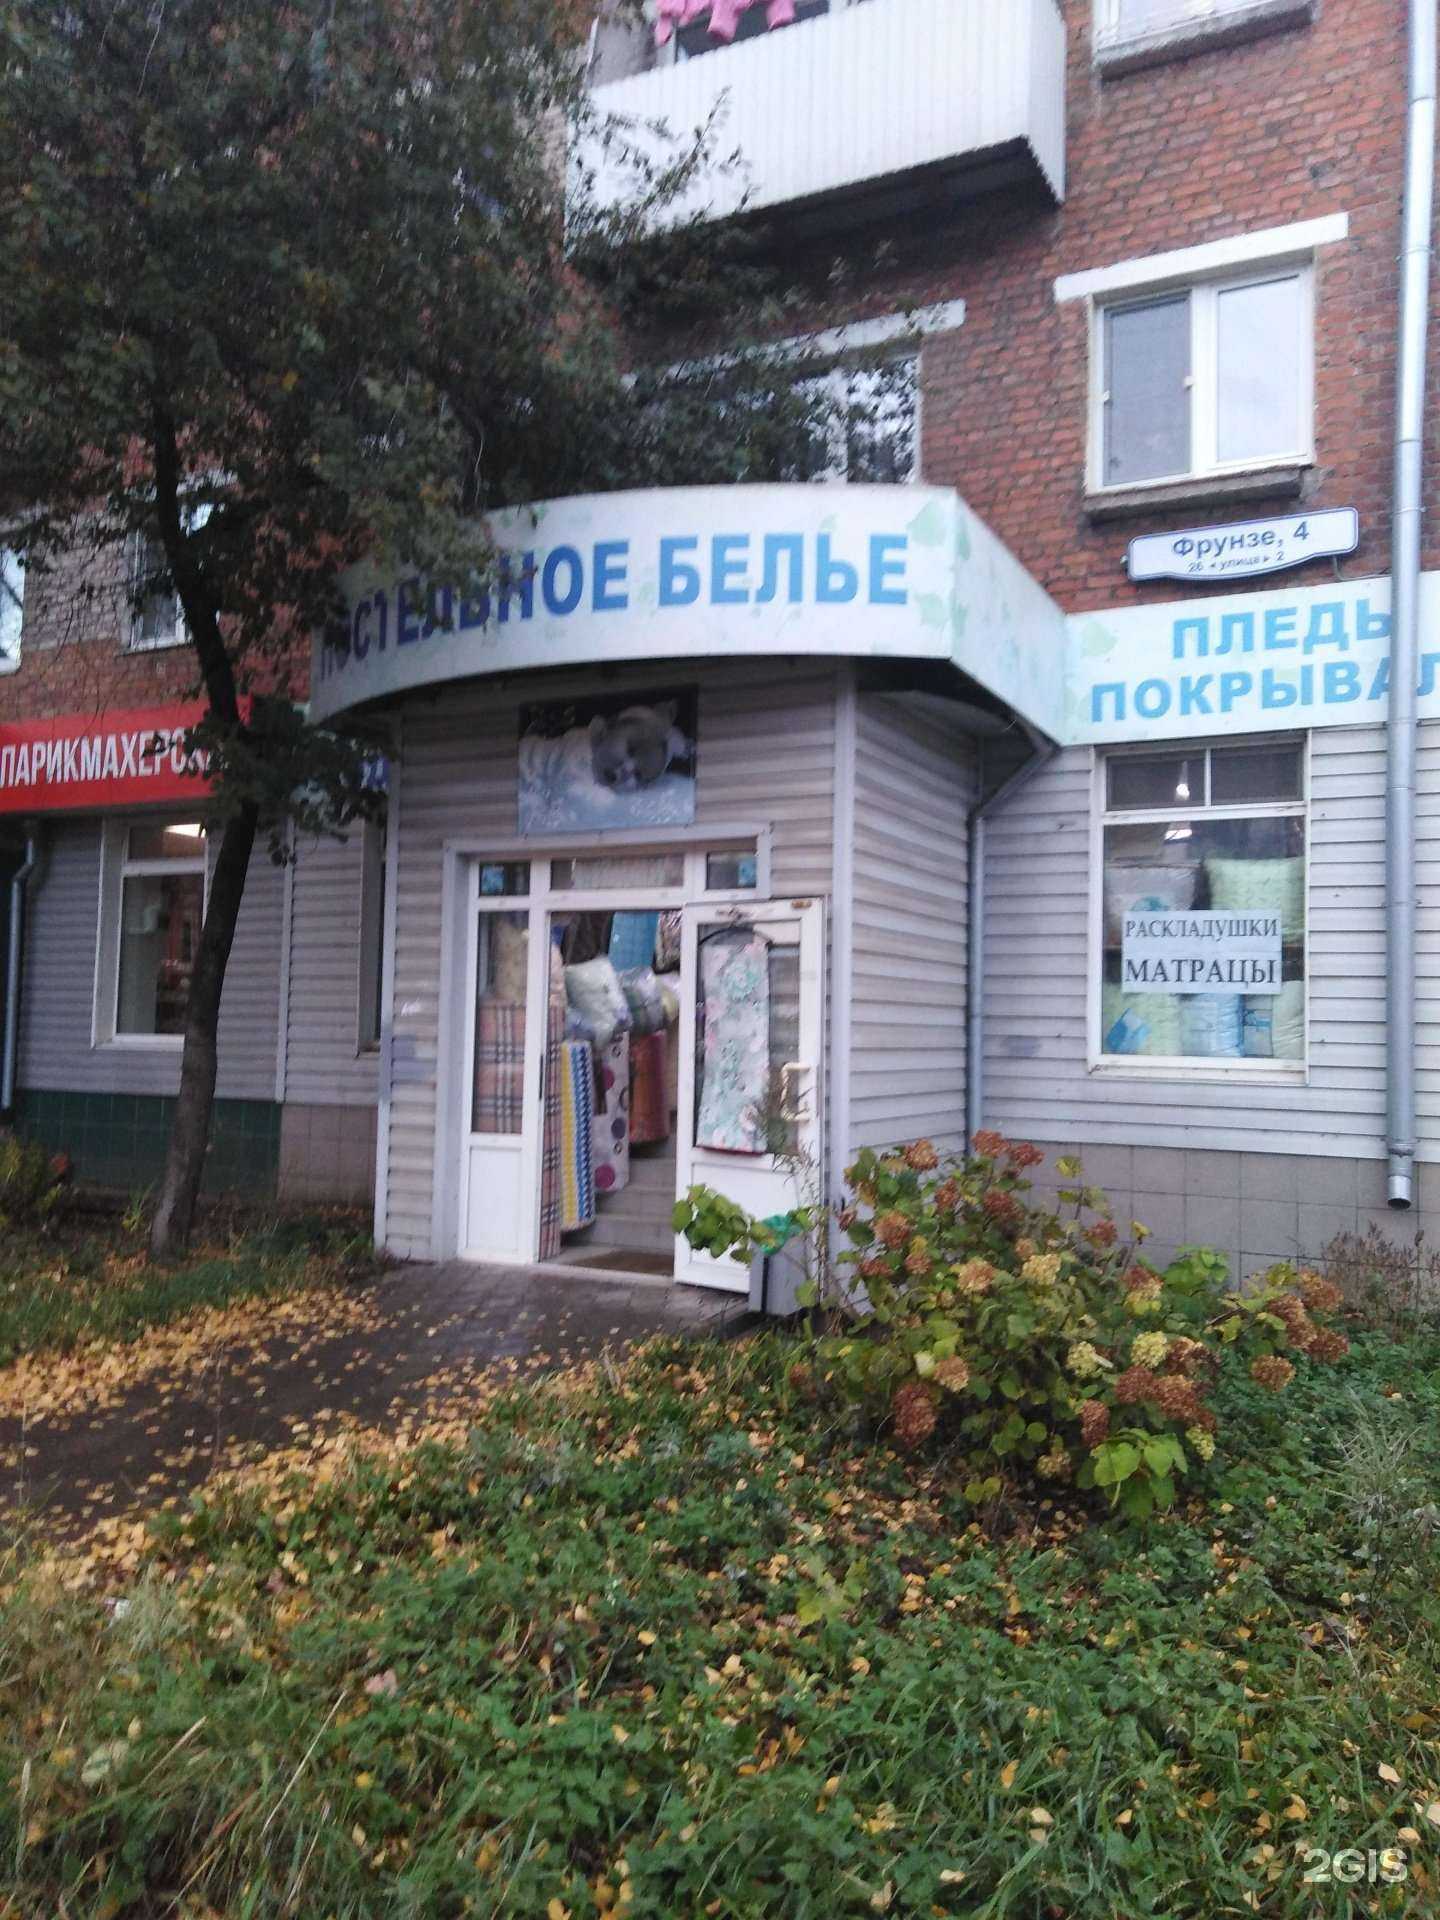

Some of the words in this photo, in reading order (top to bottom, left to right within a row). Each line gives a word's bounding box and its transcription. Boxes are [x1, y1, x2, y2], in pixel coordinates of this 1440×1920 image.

[1172, 527, 1284, 559] Фрунзе,
[1292, 520, 1310, 541] 4
[658, 533, 908, 607] БЕЛЬЕ
[0, 726, 220, 788] ПАРИКМАХЕРС
[1125, 918, 1279, 943] РАСКЛАДУШКИ
[1124, 958, 1277, 984] МАТРАЦЫ
